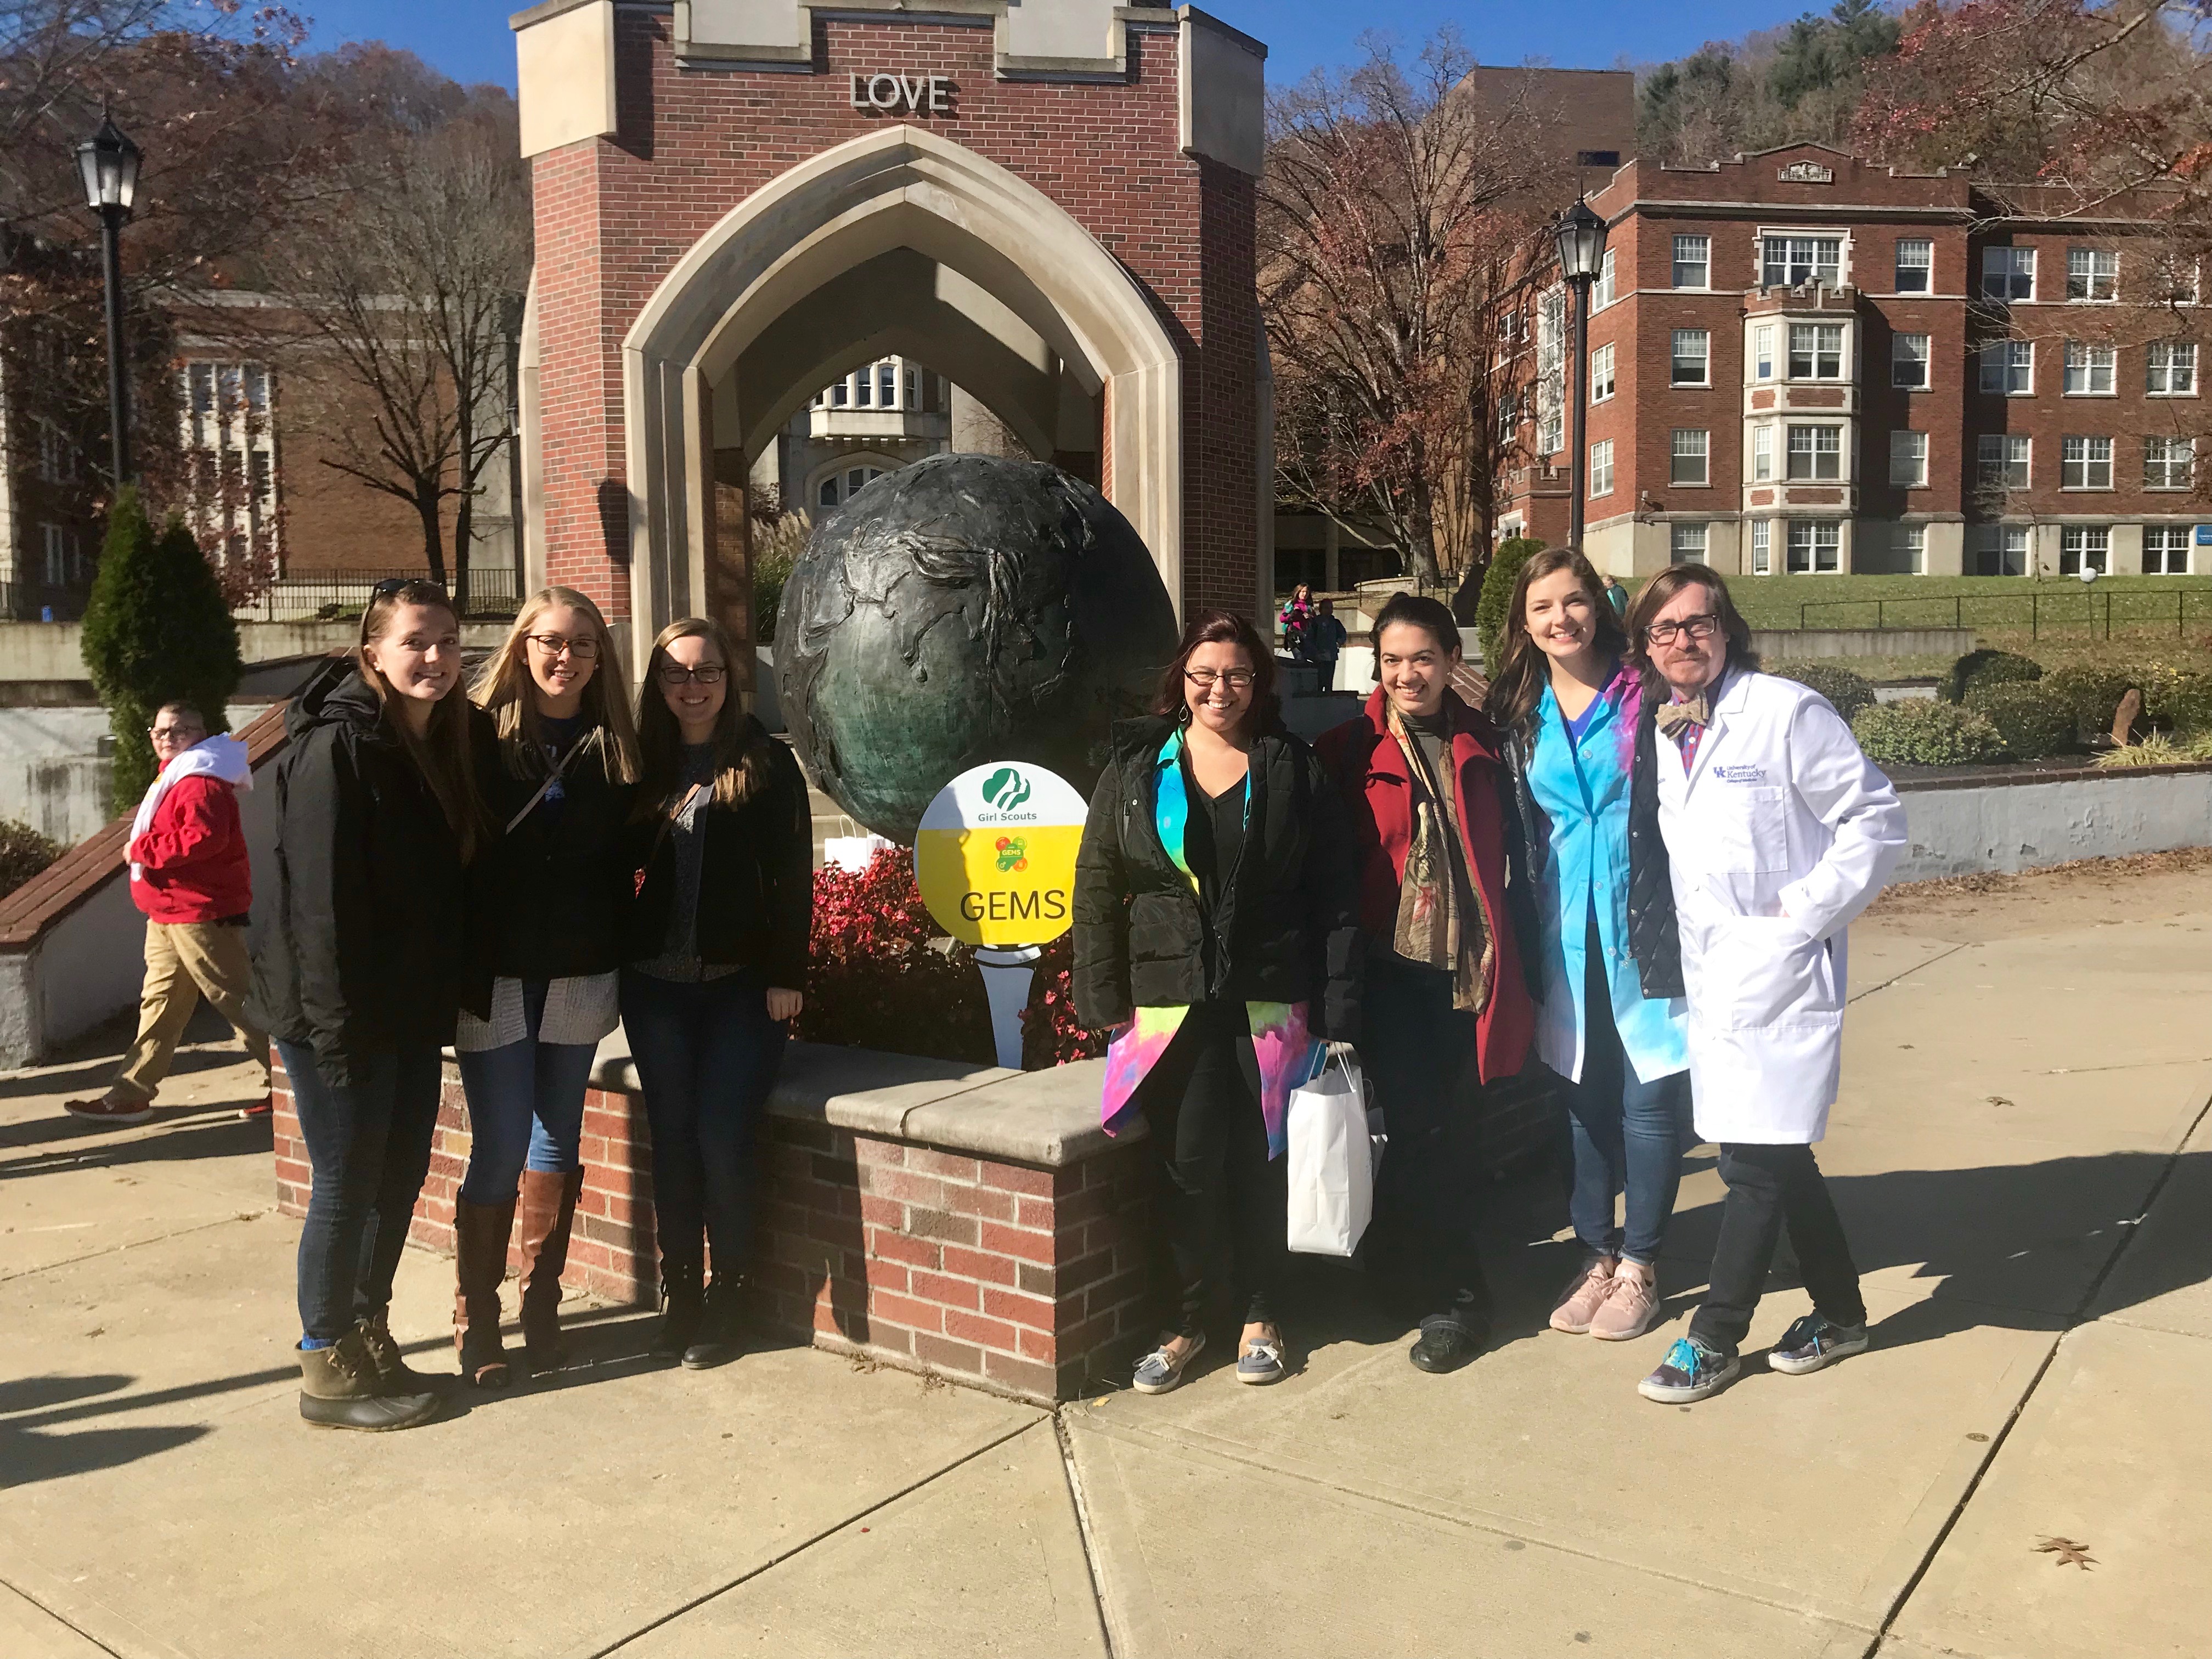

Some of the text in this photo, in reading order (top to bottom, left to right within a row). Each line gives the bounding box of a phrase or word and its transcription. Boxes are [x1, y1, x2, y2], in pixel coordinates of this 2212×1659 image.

[850, 72, 949, 110] LOVE
[1713, 766, 1726, 778] UK
[1726, 769, 1767, 778] Kentucky
[978, 812, 1037, 822] Girl Scouts
[961, 890, 1065, 922] GEMS
